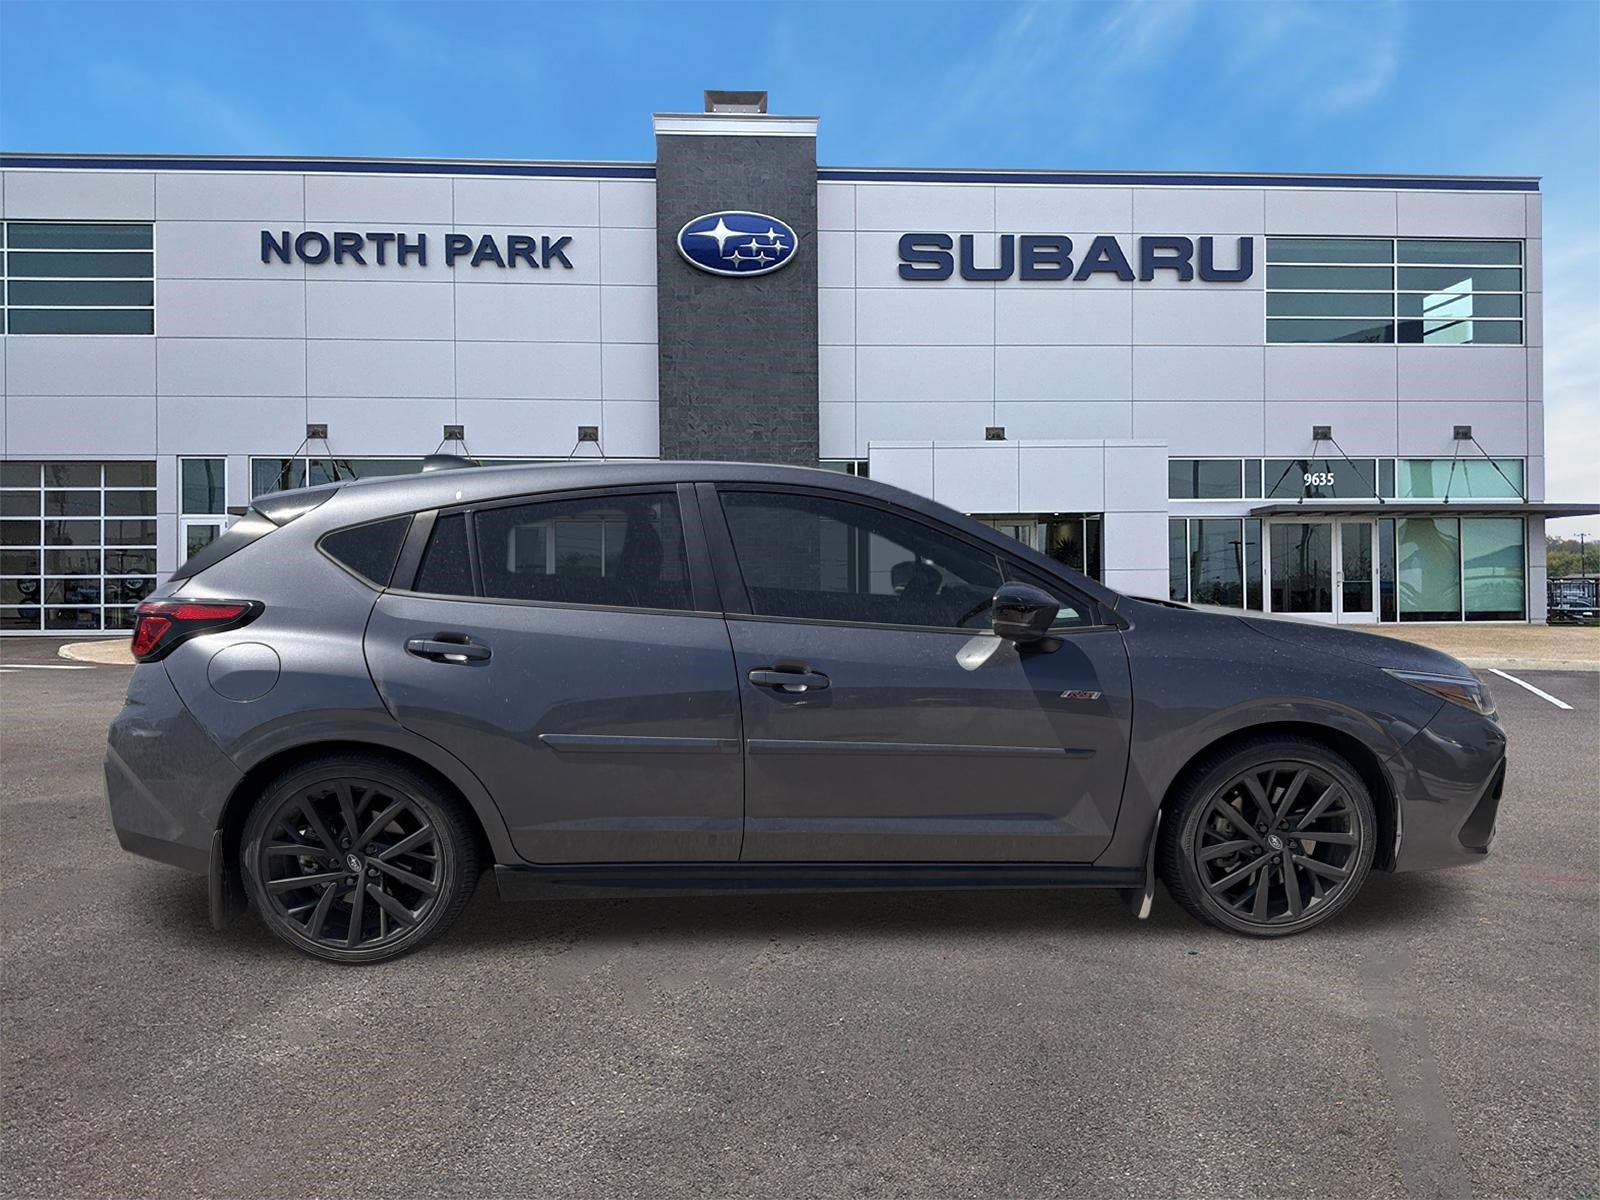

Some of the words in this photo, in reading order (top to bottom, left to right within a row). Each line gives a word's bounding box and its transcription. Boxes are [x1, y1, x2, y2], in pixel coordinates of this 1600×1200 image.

[261, 230, 427, 266] NORTH
[445, 234, 574, 270] PARK
[898, 233, 1254, 283] SUBARU
[1303, 472, 1335, 486] 9635
